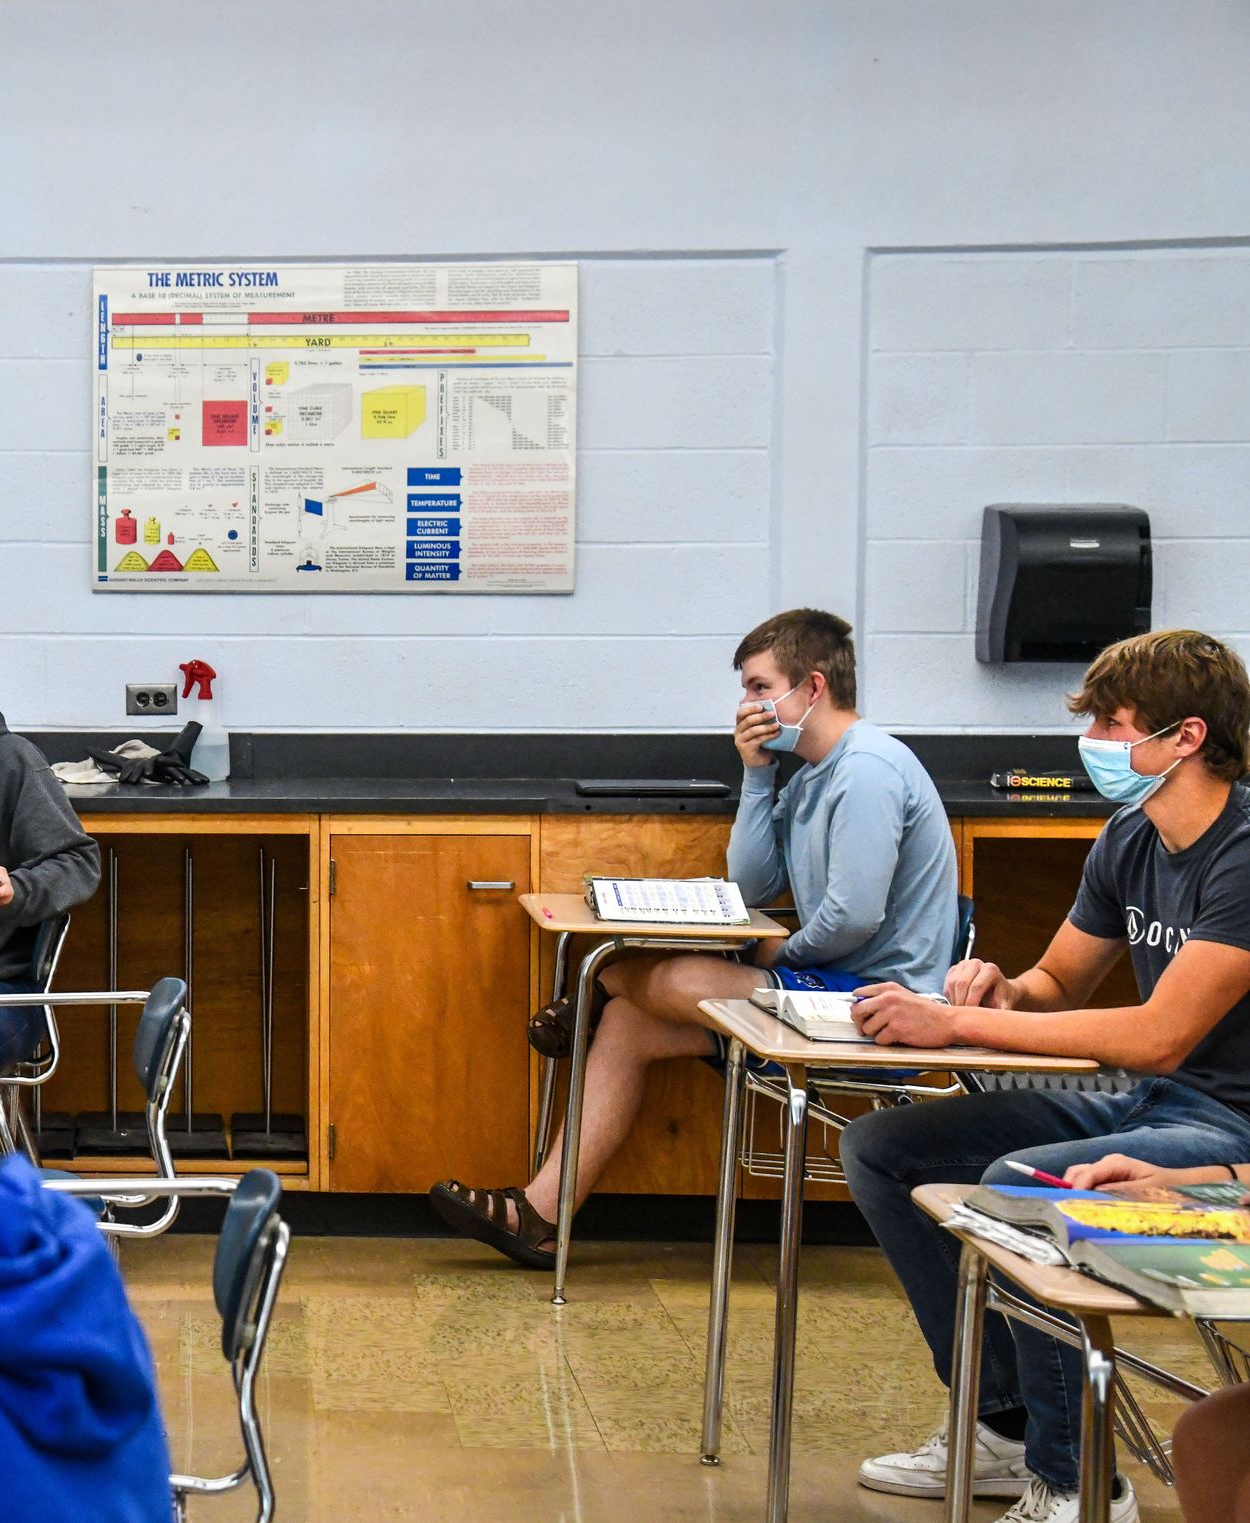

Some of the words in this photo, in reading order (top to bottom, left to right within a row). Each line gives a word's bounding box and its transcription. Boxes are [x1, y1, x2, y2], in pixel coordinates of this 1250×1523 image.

[148, 272, 171, 287] THE
[175, 272, 224, 287] METRIC
[228, 272, 279, 287] SYSTEM
[244, 291, 295, 299] MEASUREMENT
[302, 313, 335, 323] METRE
[305, 338, 332, 347] YARD
[251, 372, 259, 435] VOLUME
[410, 499, 457, 507] TEMPERATURE
[99, 495, 107, 537] MASS
[413, 542, 451, 550] LUMINOUS
